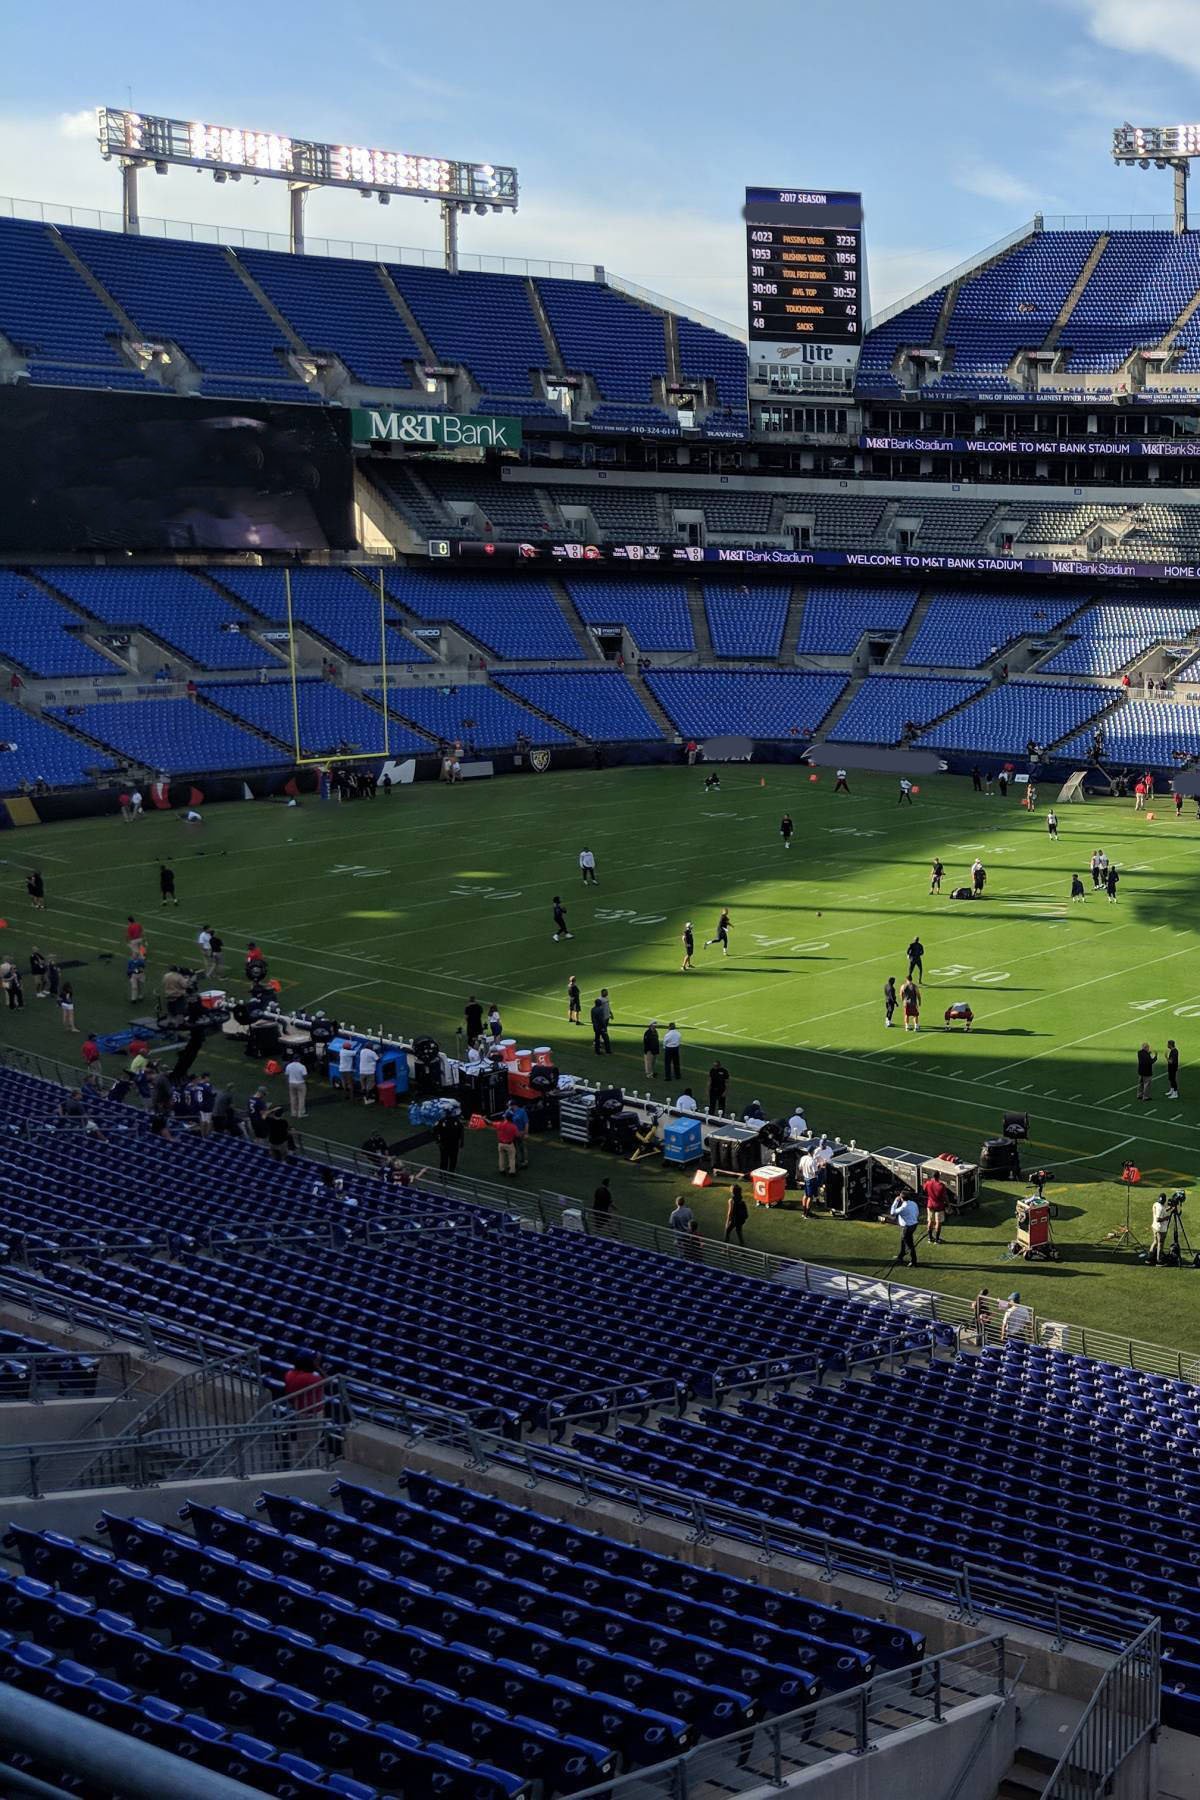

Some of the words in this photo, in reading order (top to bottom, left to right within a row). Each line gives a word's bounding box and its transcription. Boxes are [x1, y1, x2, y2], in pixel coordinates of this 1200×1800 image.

[780, 193, 796, 203] 2017
[798, 194, 826, 204] SEASON
[751, 232, 773, 242] 4023
[836, 235, 856, 246] 3235
[751, 249, 771, 259] 1953
[836, 252, 856, 263] 1856
[752, 267, 764, 276] 311
[844, 271, 856, 281] 311
[752, 284, 777, 295] 30:06
[833, 288, 856, 298] 30:52
[753, 301, 762, 311] 51
[786, 305, 824, 314] TOUCHDOWNS
[846, 305, 856, 315] 42
[753, 319, 764, 329] 48
[797, 323, 813, 331] SACKS
[847, 322, 856, 332] 41
[801, 344, 833, 364] Lite
[369, 411, 441, 442] M&T
[443, 416, 508, 446] Bank
[866, 438, 890, 448] M&T
[891, 439, 914, 449] Bank
[915, 440, 953, 450] Stadium
[967, 441, 1017, 451] WELCOME
[1020, 443, 1034, 451] TO
[1036, 443, 1058, 452] M&T
[1060, 444, 1086, 453] BANK
[1088, 444, 1129, 453] STADIUM
[1141, 444, 1164, 454] M&T
[1165, 445, 1187, 455] Bank
[719, 550, 746, 560] M&T
[746, 551, 771, 562] Bank
[772, 552, 813, 563] Stadium
[847, 555, 901, 565] WELCOME
[904, 557, 919, 566] TO
[922, 558, 944, 567] M&T
[948, 559, 977, 568] BANK
[978, 560, 1023, 570] STADIUM
[1052, 562, 1075, 572] M&T
[1076, 563, 1098, 573] Bank
[1099, 564, 1135, 575] Stadium
[1165, 567, 1194, 576] HOME
[928, 964, 1010, 983] 50
[755, 1181, 766, 1196] G
